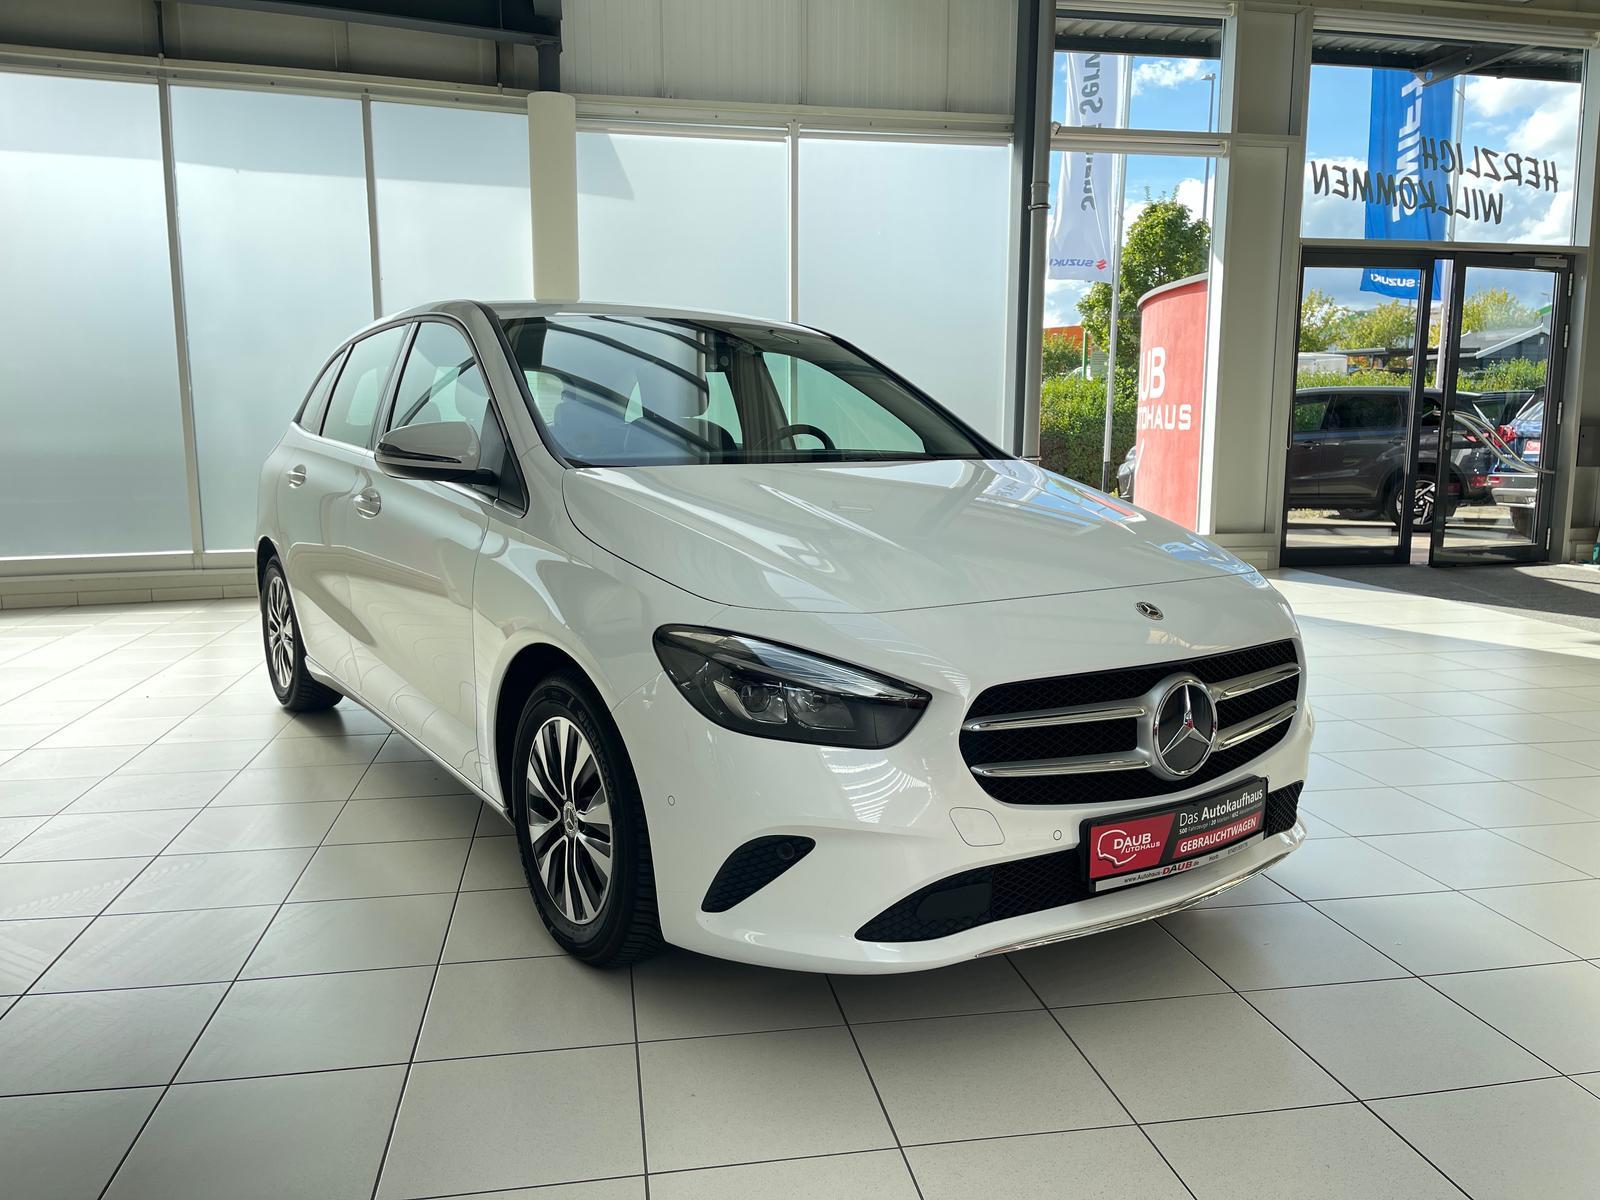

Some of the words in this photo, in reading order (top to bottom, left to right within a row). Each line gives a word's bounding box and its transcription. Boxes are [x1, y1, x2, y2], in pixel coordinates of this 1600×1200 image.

[1179, 812, 1199, 827] Das
[1201, 789, 1263, 821] Autokaufhaus
[1113, 832, 1152, 853] DAUB
[1180, 816, 1257, 853] GEBRAUCHTWAGEN
